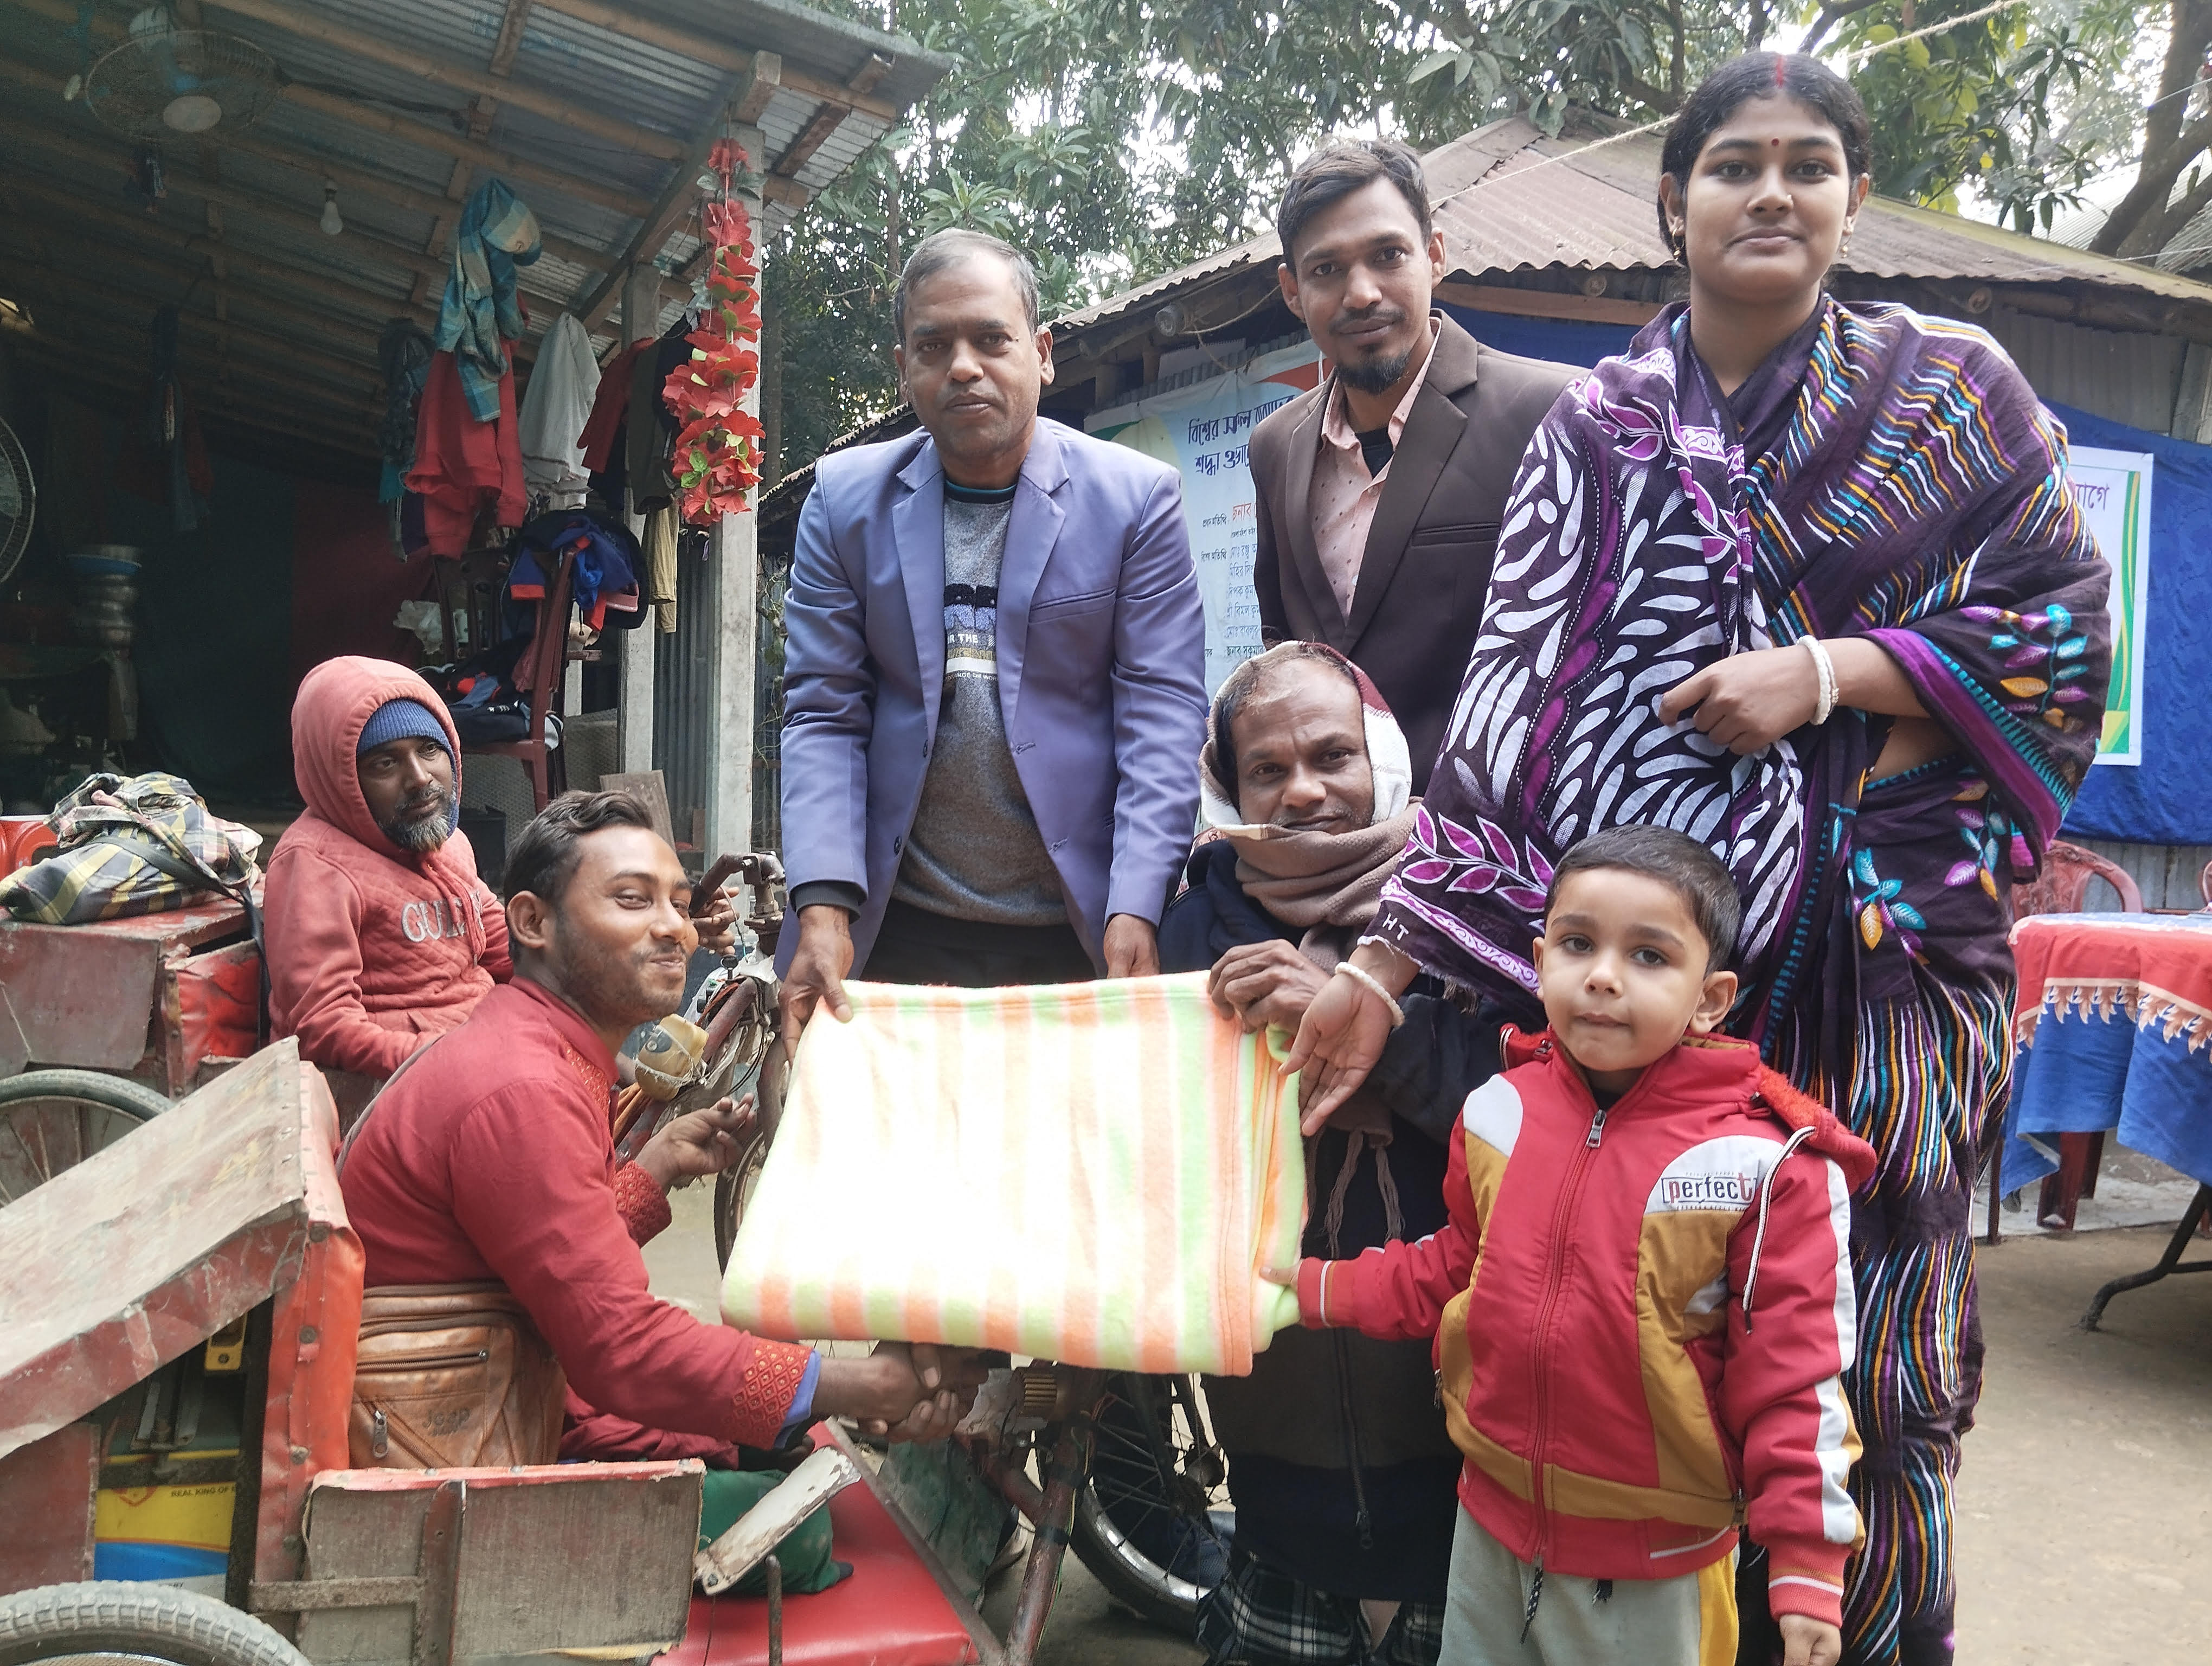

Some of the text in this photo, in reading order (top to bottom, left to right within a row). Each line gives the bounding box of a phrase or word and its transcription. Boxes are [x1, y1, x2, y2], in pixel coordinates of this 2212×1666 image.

[1232, 502, 1251, 521] জনাব
[957, 633, 979, 644] THE
[1668, 1172, 1752, 1203] perfect
[195, 1486, 216, 1497] KING
[218, 1485, 229, 1494] OF
